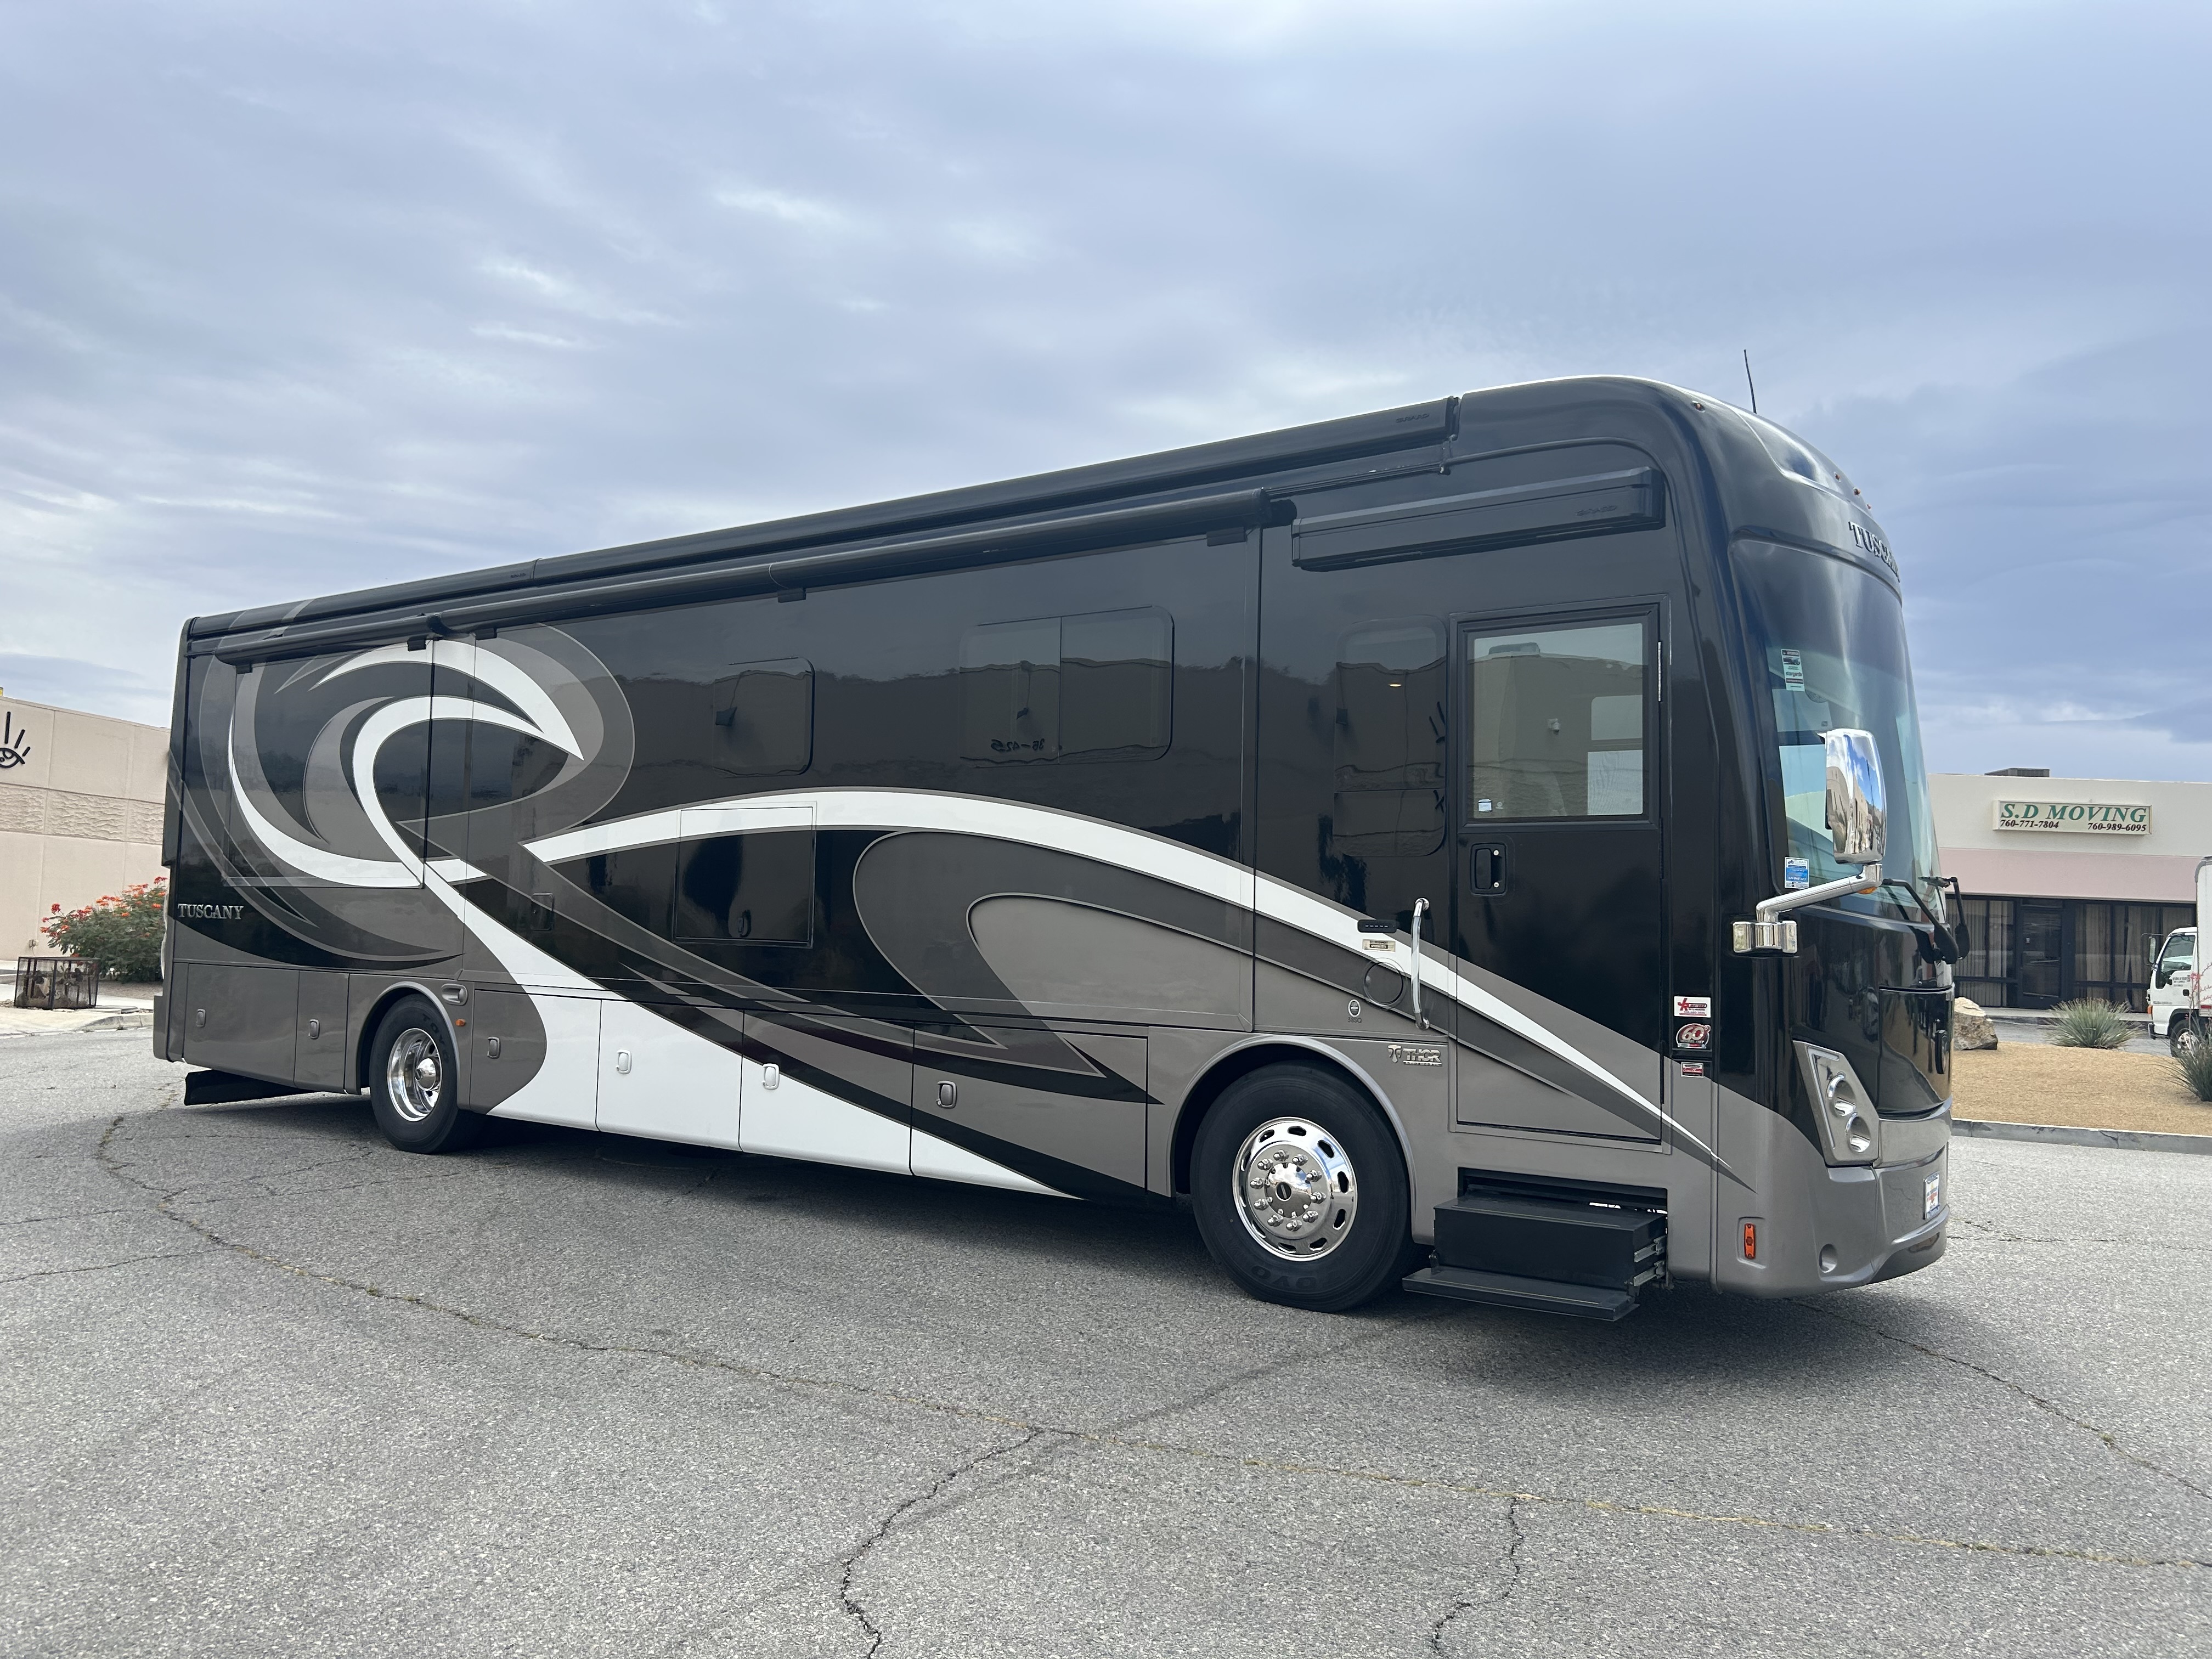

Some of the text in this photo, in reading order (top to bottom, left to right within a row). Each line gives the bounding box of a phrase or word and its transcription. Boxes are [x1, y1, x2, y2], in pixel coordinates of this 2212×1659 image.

[1848, 521, 1900, 583] TUSCA
[2001, 804, 2147, 822] S.D MOVING
[2000, 819, 2147, 832] 760-771-7804 760-989-6095
[177, 903, 244, 920] TUSCANY
[1403, 1048, 1441, 1062] THOR
